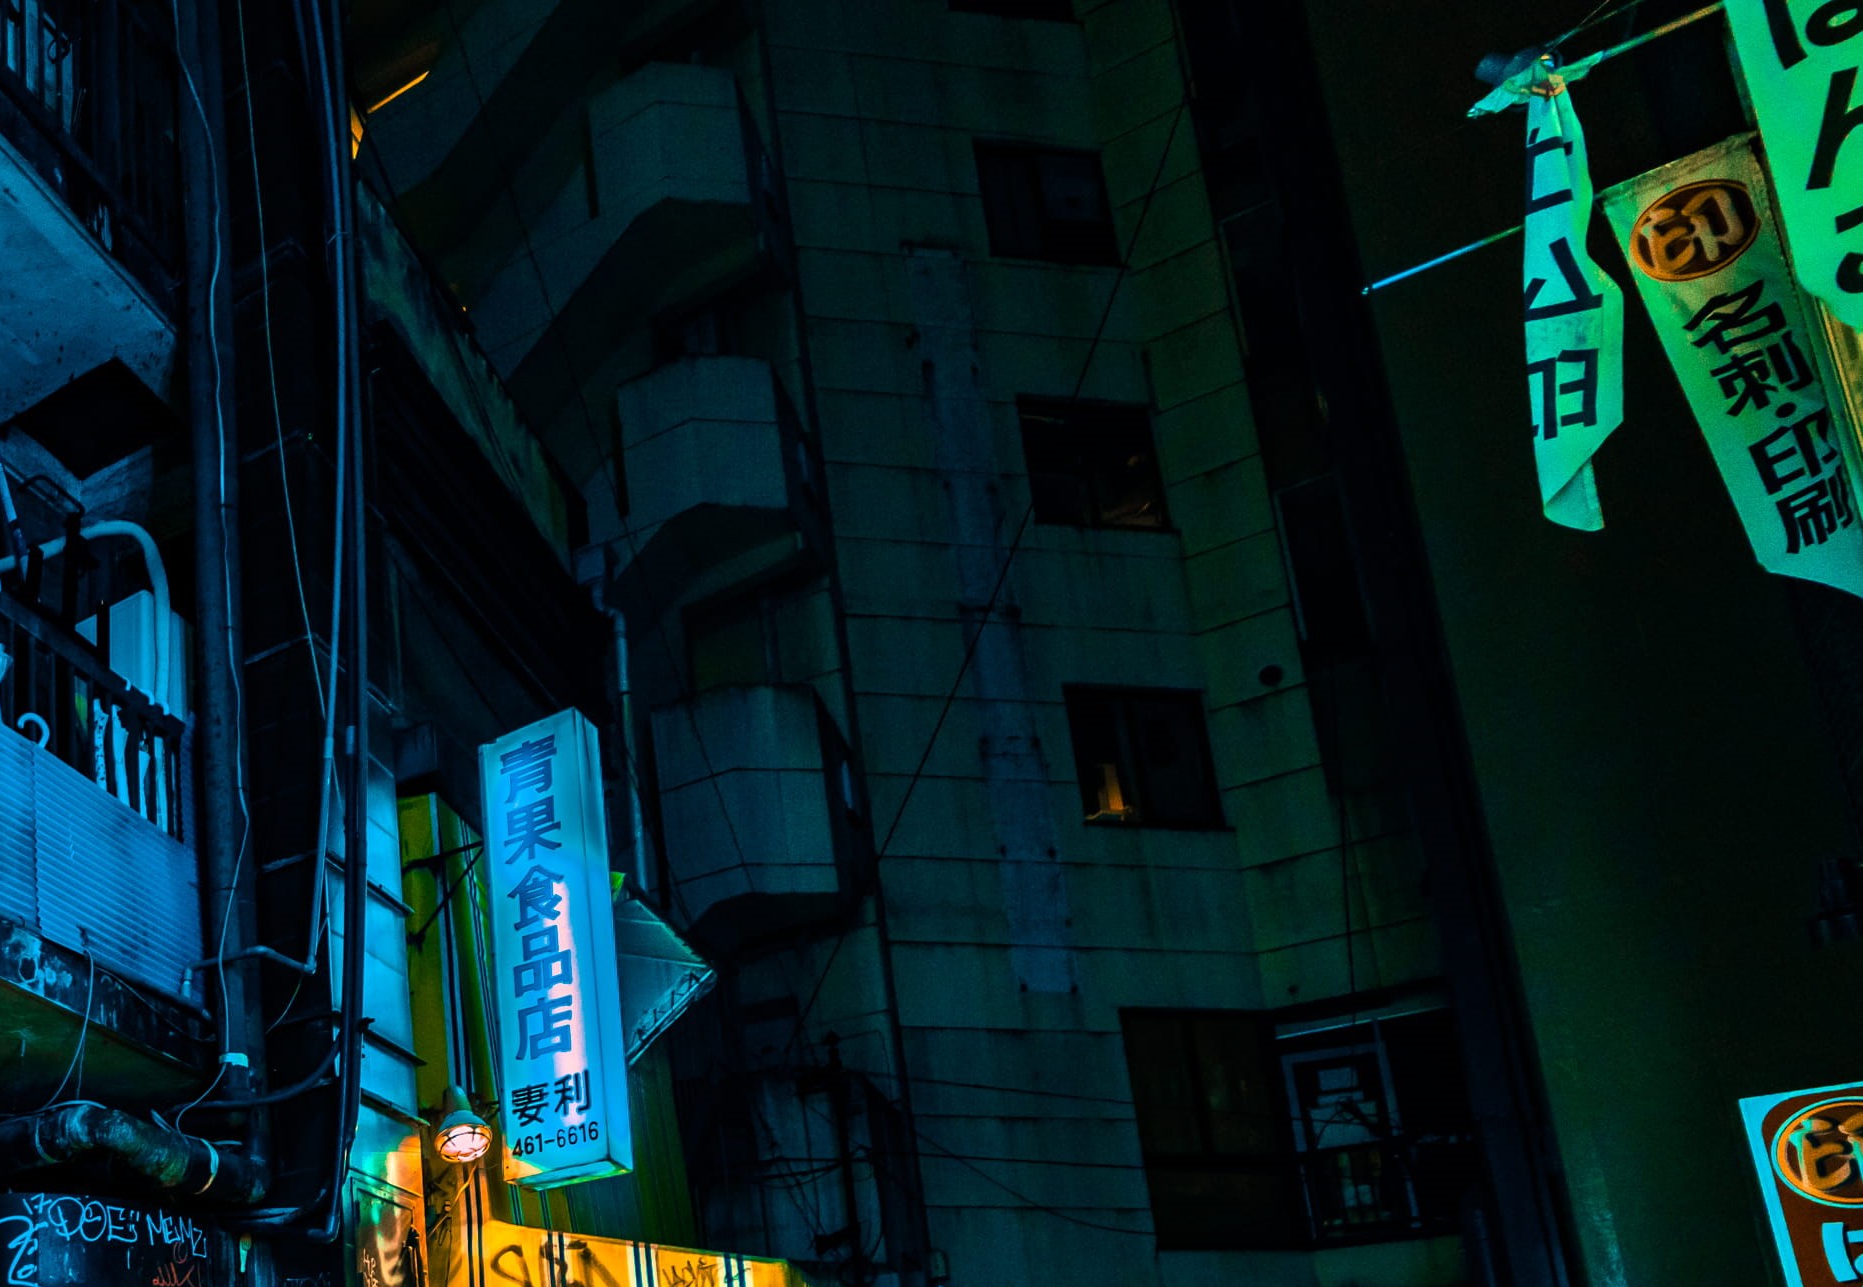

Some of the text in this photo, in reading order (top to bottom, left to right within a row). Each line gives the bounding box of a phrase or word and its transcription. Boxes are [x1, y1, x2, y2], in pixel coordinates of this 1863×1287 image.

[1683, 280, 1855, 554] 名刺・印刷
[499, 732, 574, 1062] 青果食品店
[512, 1119, 600, 1159] 461-6616
